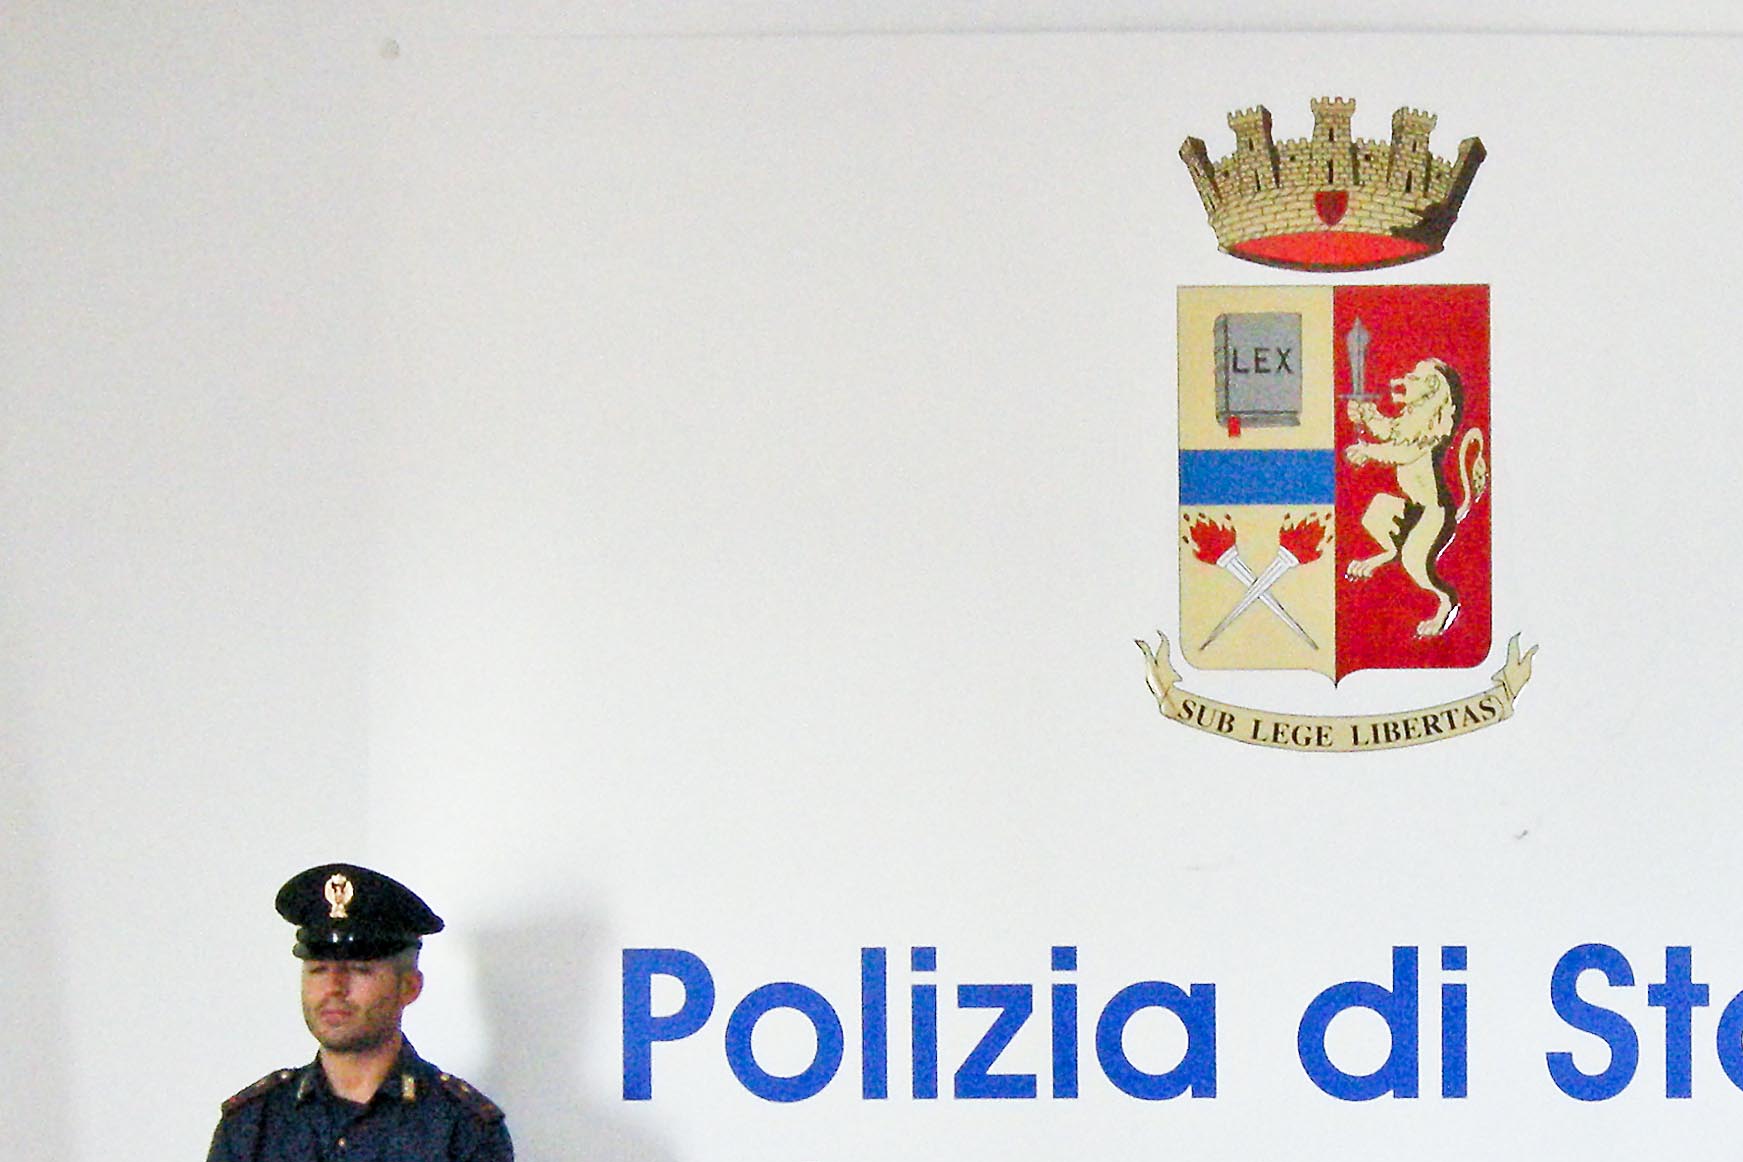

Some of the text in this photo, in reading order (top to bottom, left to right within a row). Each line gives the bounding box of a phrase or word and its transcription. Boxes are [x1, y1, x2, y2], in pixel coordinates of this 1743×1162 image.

[1231, 346, 1294, 374] LEX
[1176, 698, 1498, 748] SUB LEGE LIBERTAS
[621, 945, 1218, 1104] Polizia
[1296, 944, 1469, 1104] di
